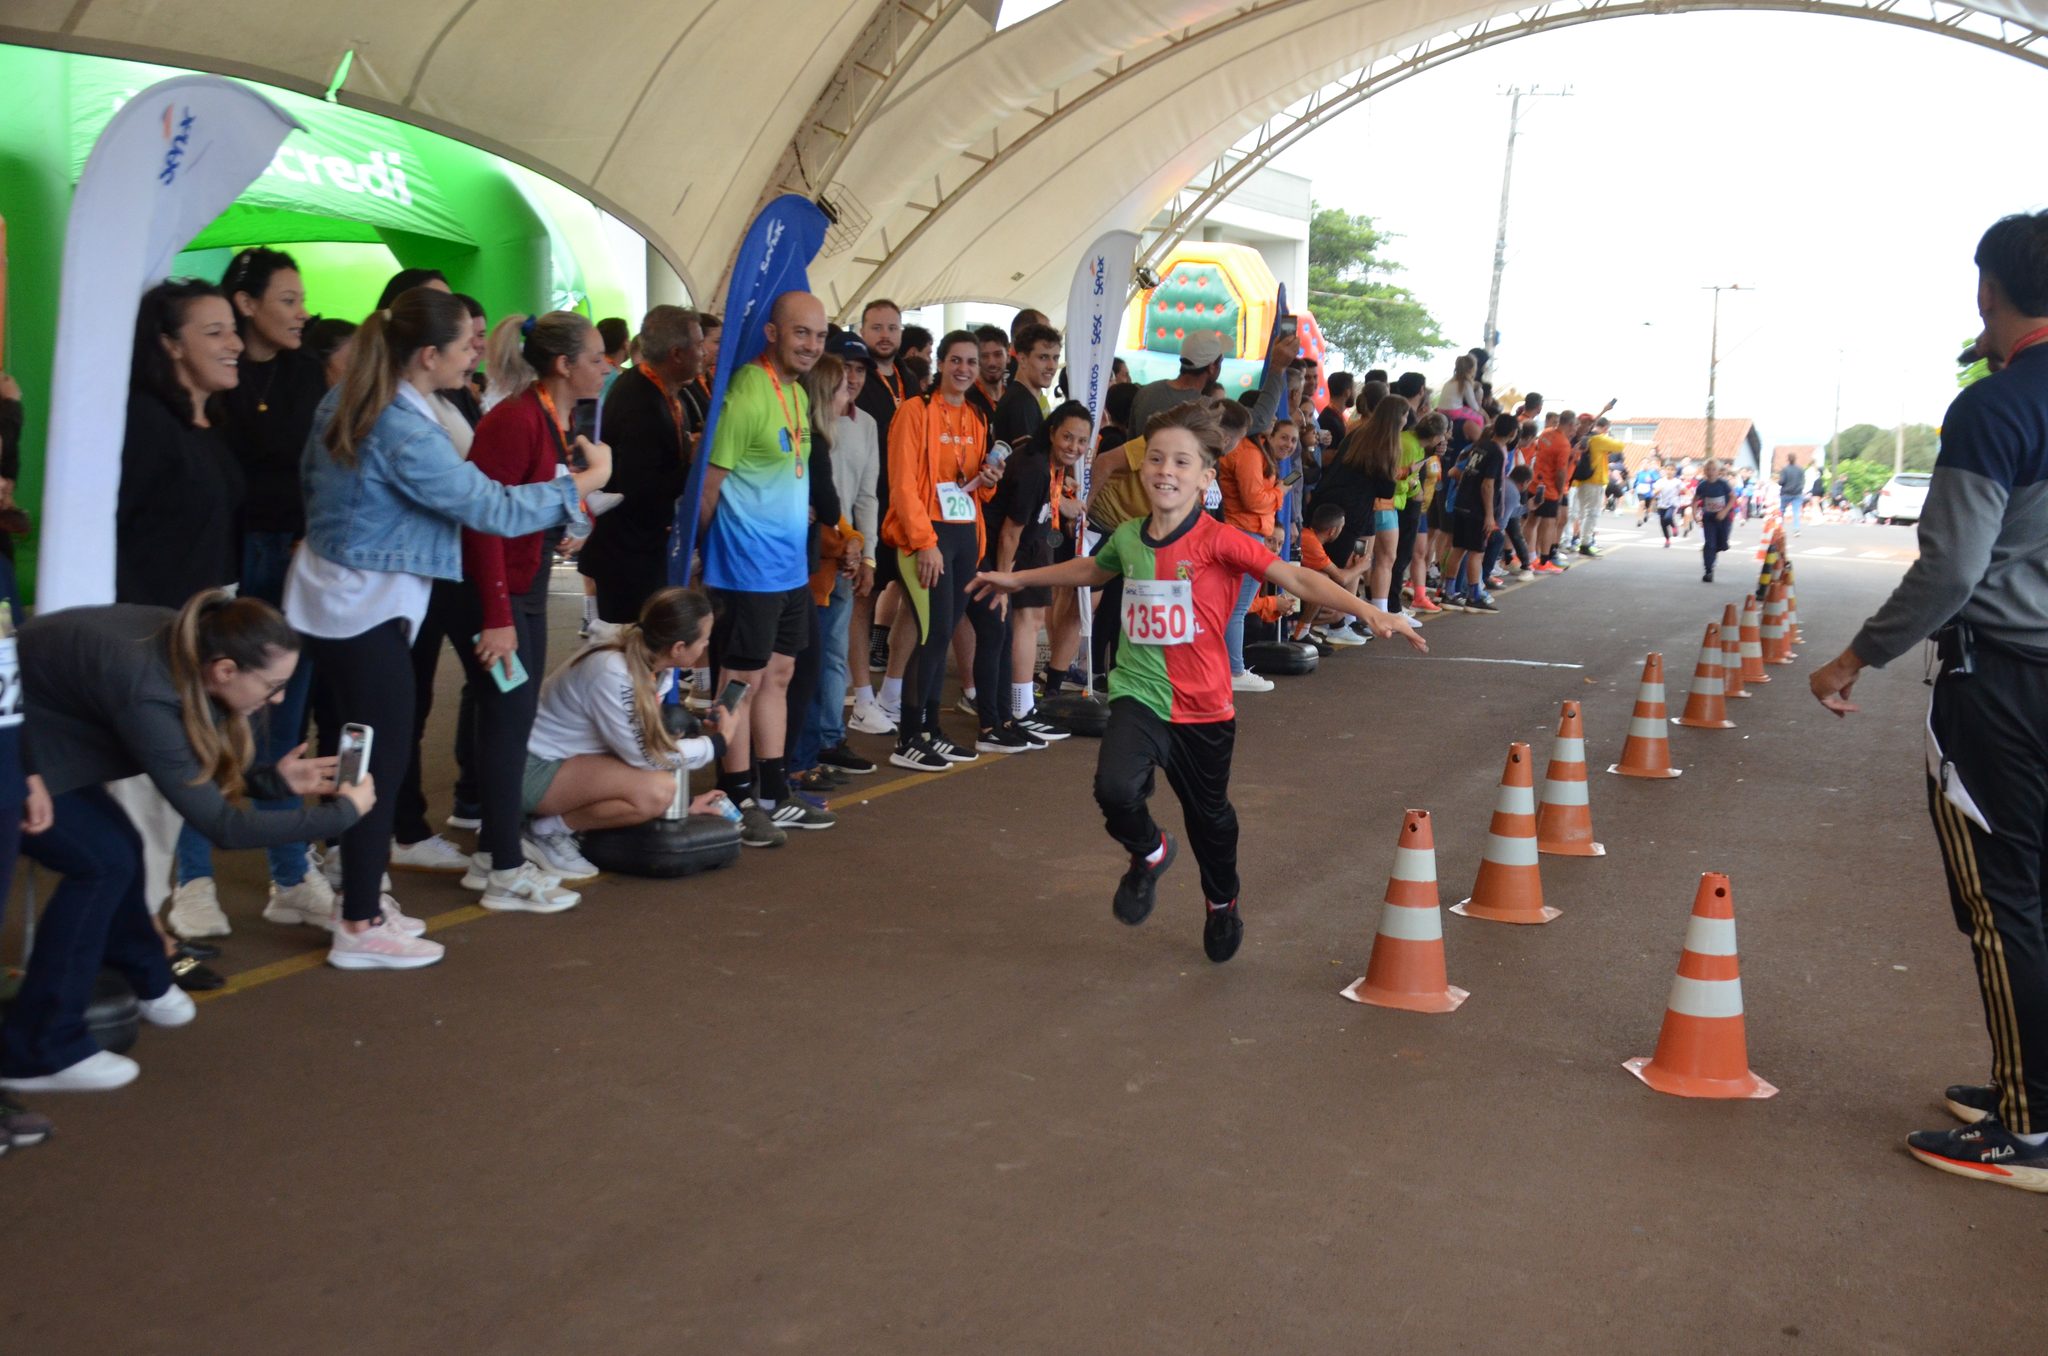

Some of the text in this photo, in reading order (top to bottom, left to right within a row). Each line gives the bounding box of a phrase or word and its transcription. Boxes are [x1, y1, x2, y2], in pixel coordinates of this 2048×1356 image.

[262, 145, 412, 206] credi
[1093, 256, 1105, 295] Senac
[1091, 314, 1103, 345] Sesc
[946, 496, 973, 517] 261
[1126, 603, 1187, 639] 1350
[1981, 1144, 2016, 1162] FILA
